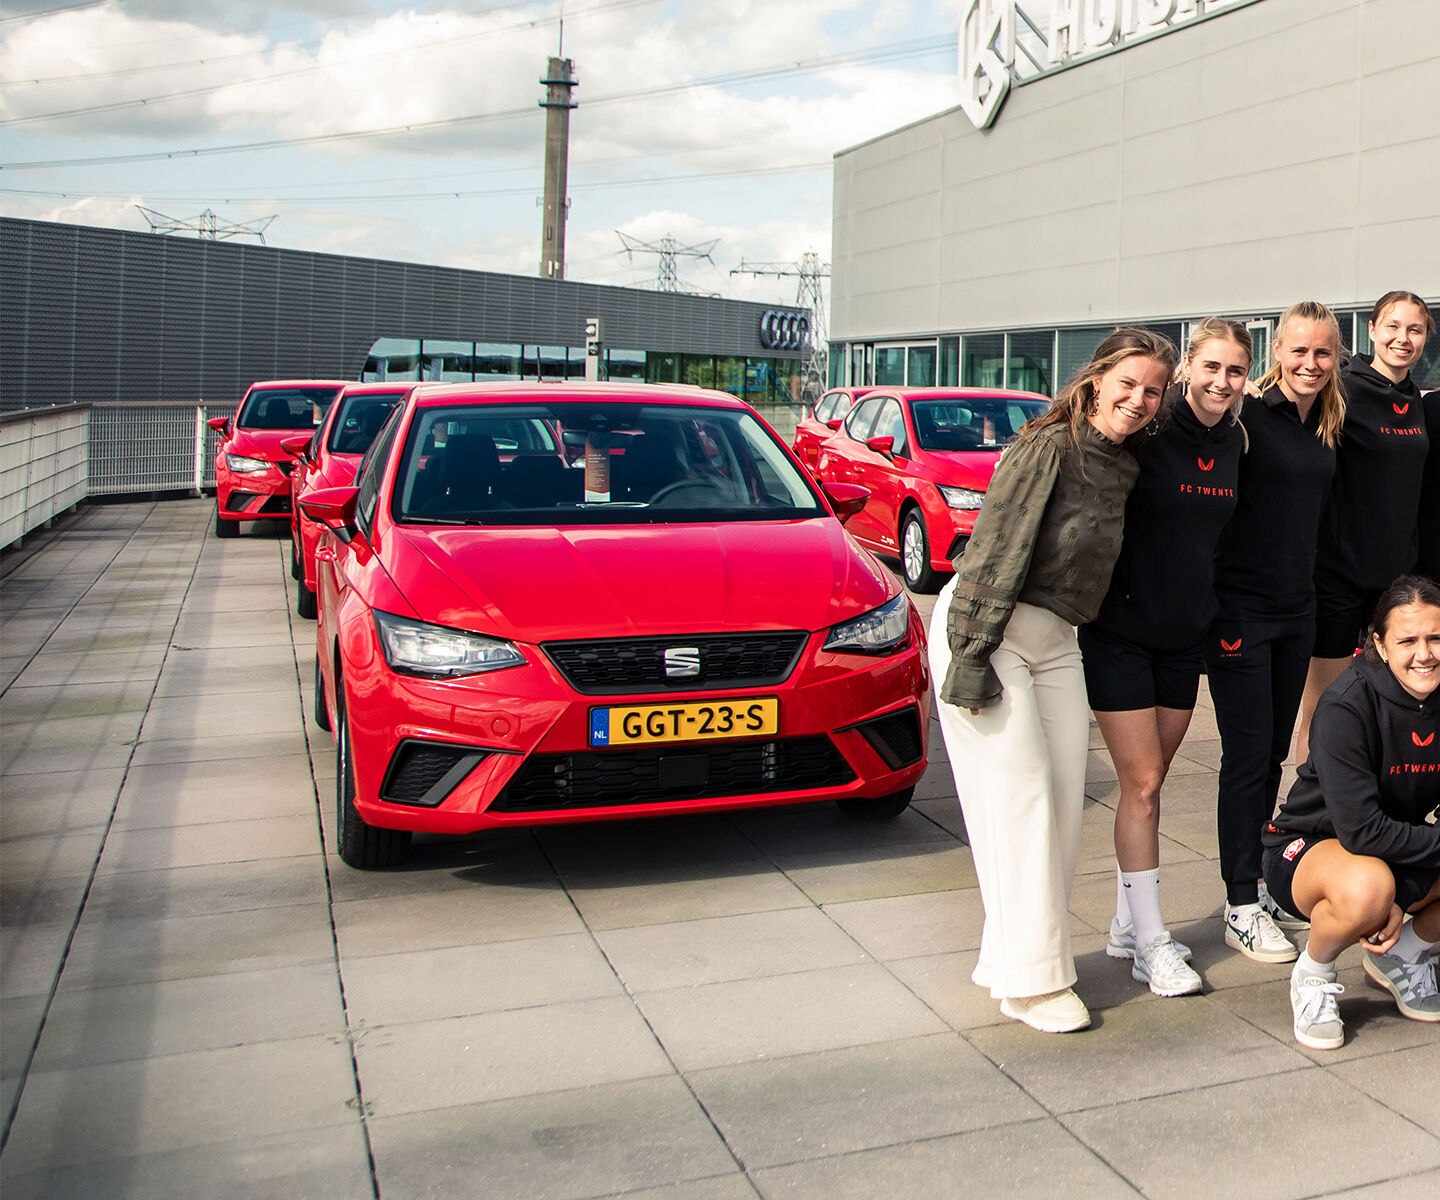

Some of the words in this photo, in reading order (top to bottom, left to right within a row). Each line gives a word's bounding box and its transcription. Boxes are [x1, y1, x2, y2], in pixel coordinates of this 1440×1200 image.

[1380, 426, 1391, 435] FC
[1392, 427, 1422, 436] TWENTE
[1180, 483, 1193, 493] FC
[622, 704, 764, 739] GGT-23-S
[593, 730, 607, 740] NL
[1390, 764, 1401, 775] FC
